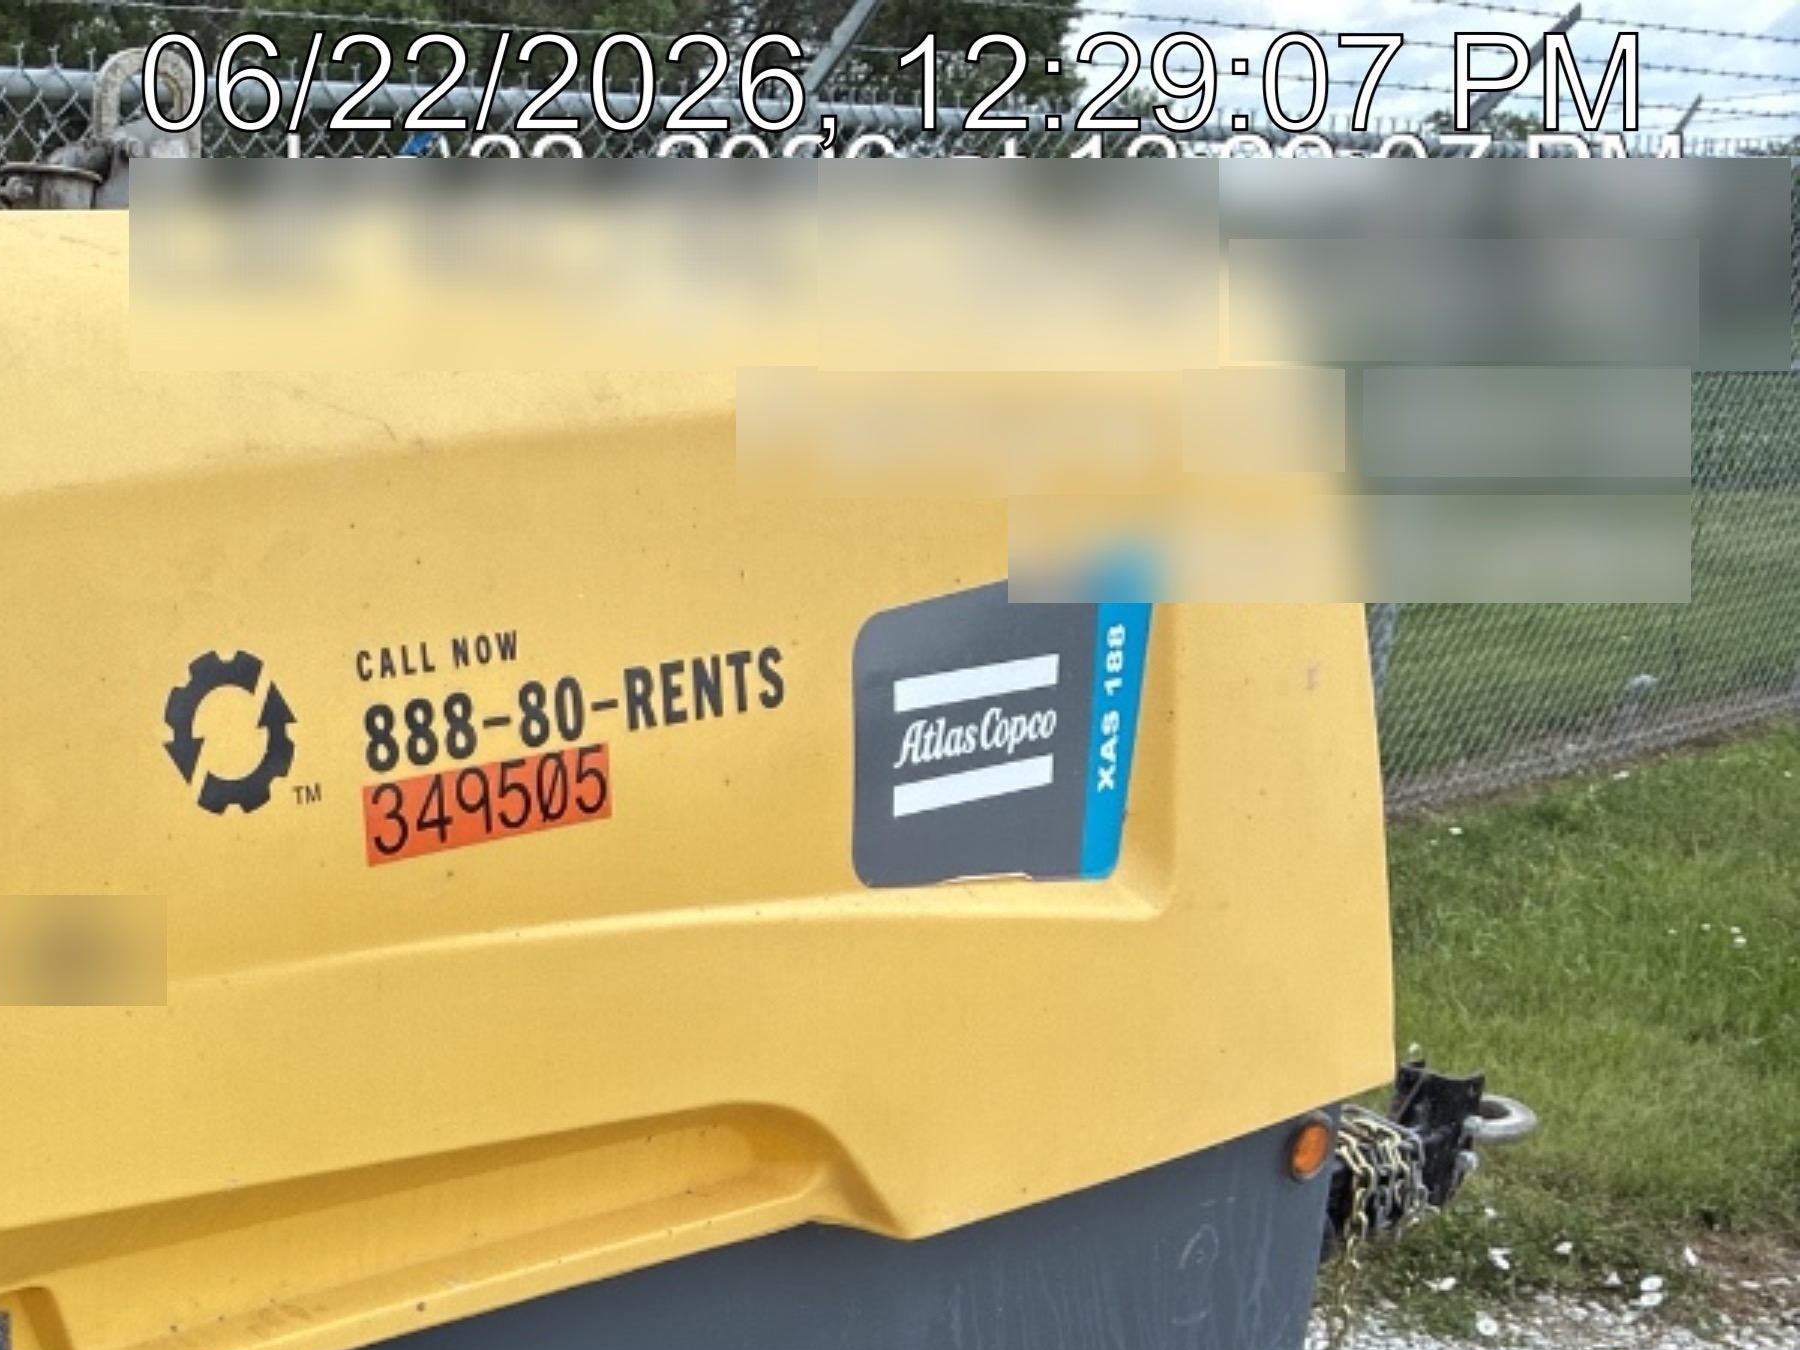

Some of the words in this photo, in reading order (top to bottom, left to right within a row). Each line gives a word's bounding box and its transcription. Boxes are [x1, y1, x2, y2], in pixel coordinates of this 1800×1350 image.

[356, 642, 435, 681] CALL
[452, 630, 518, 669] NOW
[1104, 624, 1126, 696] 188
[363, 646, 785, 772] 888-80-RENTS
[1098, 710, 1121, 792] XAS
[370, 744, 608, 855] 349505
